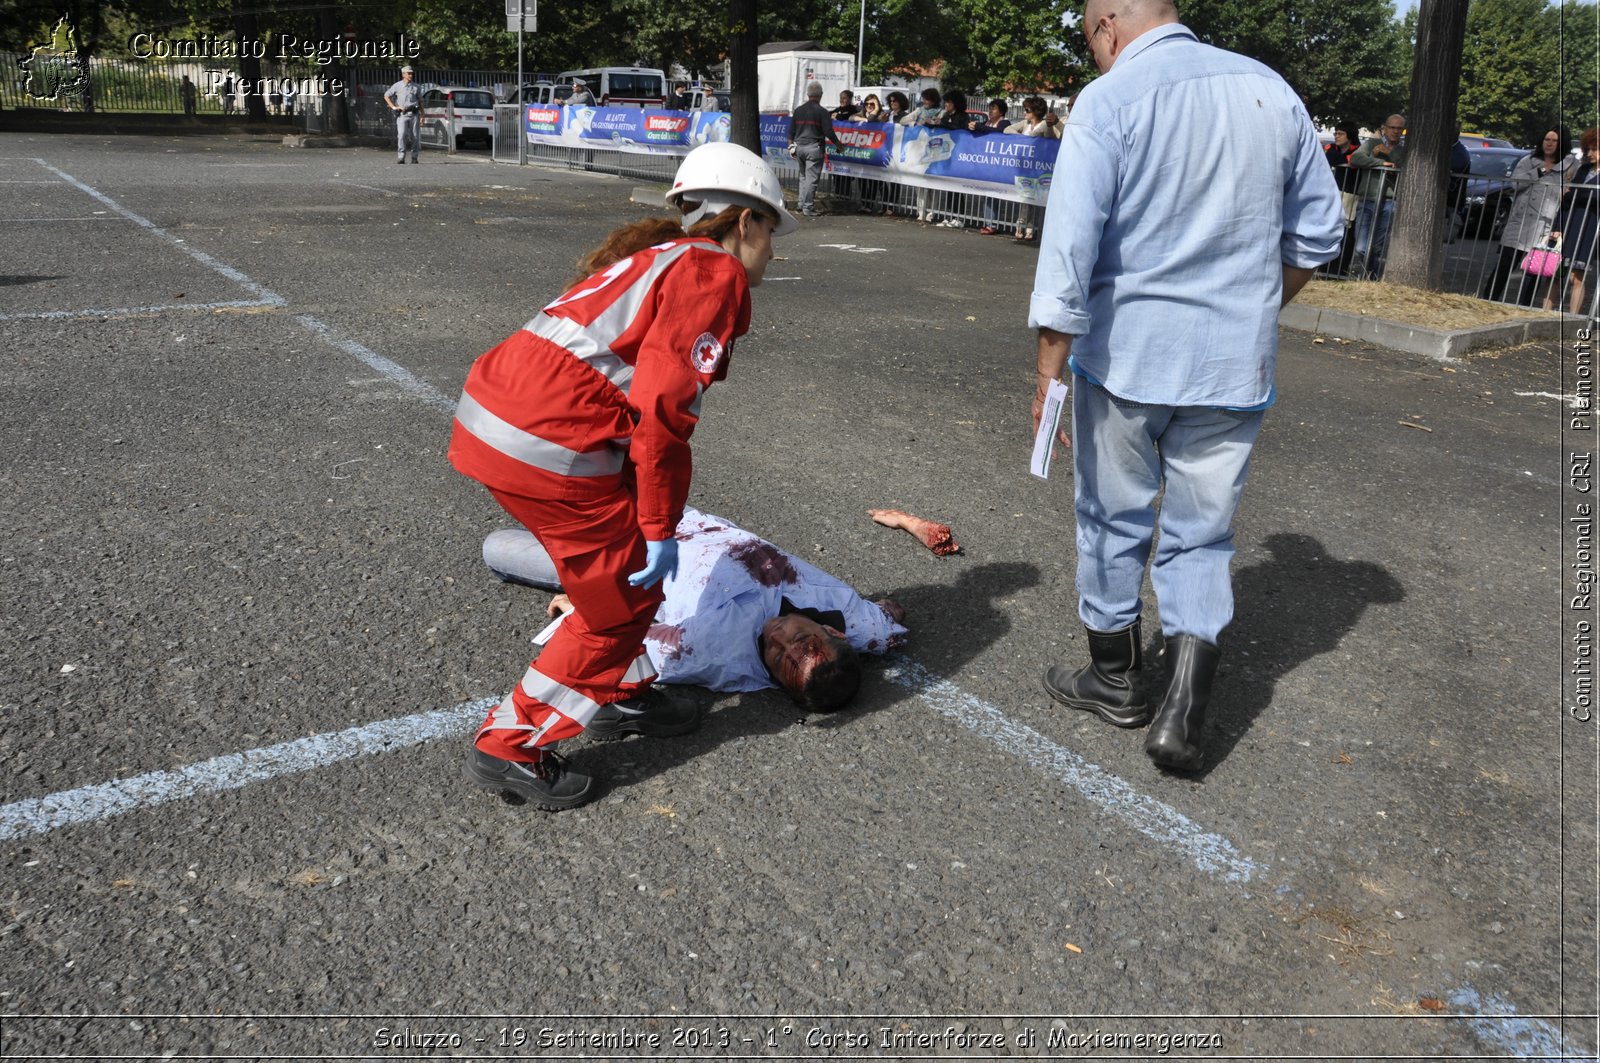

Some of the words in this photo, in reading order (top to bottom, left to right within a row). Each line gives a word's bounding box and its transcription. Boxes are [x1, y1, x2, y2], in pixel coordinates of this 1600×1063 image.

[649, 116, 682, 131] inalpi
[985, 141, 996, 154] IL
[999, 142, 1036, 158] LATTE
[958, 152, 989, 164] SBOCCIA
[990, 156, 1000, 165] IN
[1002, 157, 1021, 168] FIOR
[1023, 160, 1033, 169] DI
